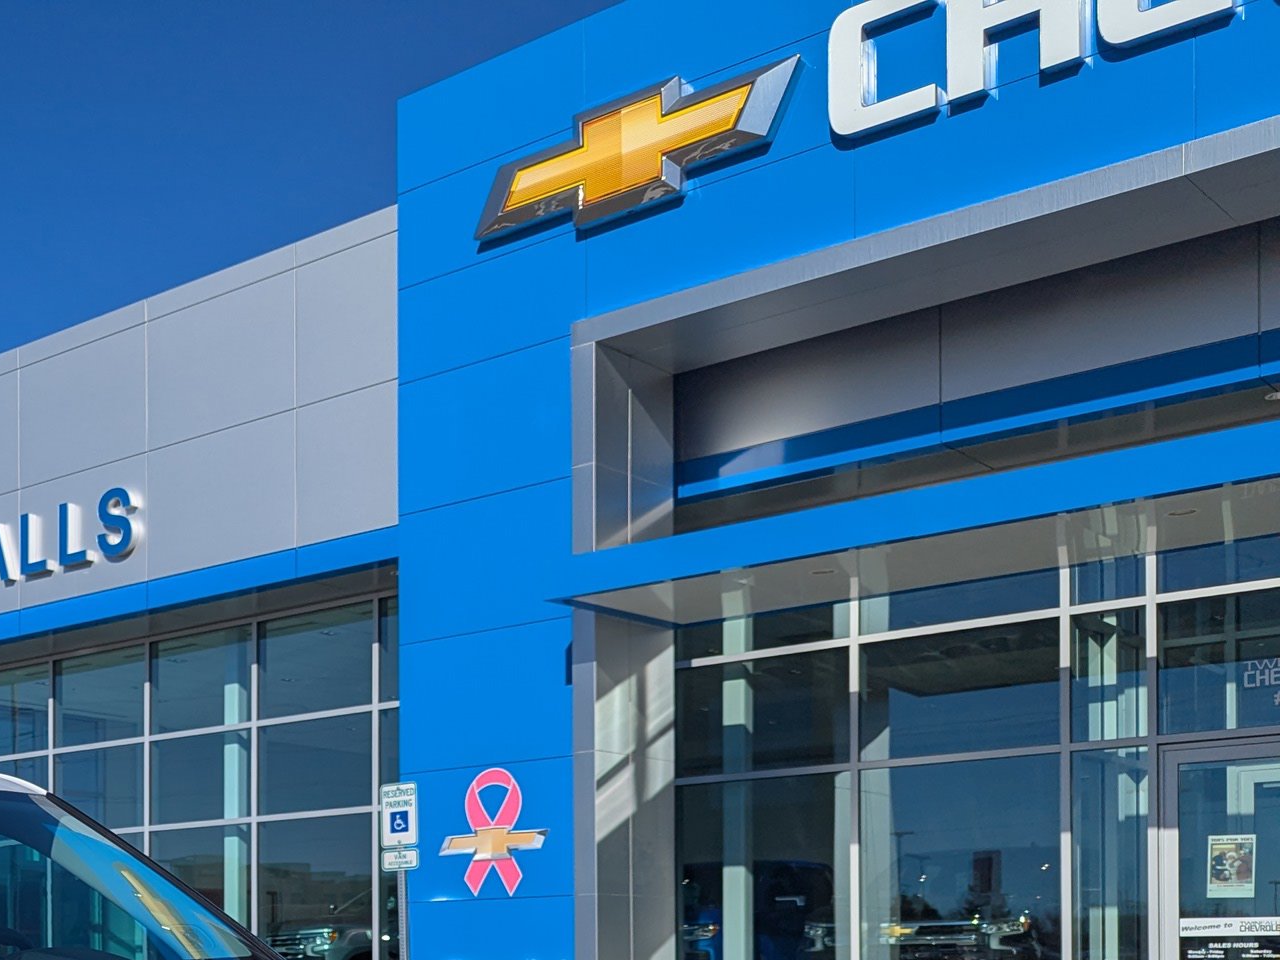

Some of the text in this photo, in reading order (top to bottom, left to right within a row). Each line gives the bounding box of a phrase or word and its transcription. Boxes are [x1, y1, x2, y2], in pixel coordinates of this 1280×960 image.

[382, 787, 415, 799] RESERVED
[384, 799, 413, 809] PARKING
[1181, 923, 1222, 932] Welcome
